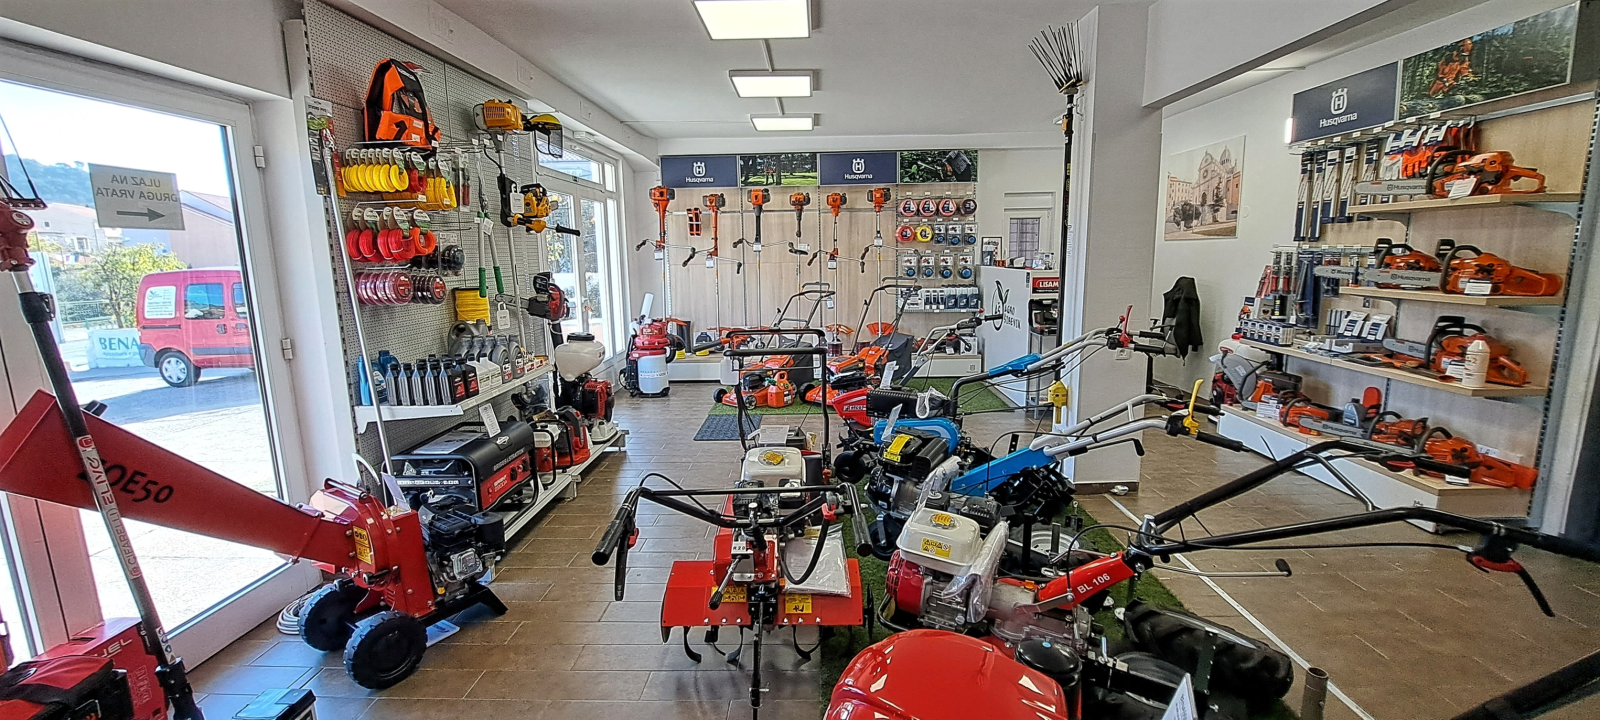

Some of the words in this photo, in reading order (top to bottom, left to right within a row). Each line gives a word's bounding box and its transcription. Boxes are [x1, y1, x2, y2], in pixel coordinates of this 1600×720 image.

[1319, 112, 1358, 128] Husqvarna
[685, 176, 714, 184] Husqvarna
[844, 173, 873, 181] Husqvarna
[1397, 274, 1431, 282] Husqvarna
[109, 511, 138, 566] CIFARELLI
[1077, 584, 1093, 594] BL
[1092, 573, 1111, 586] 106
